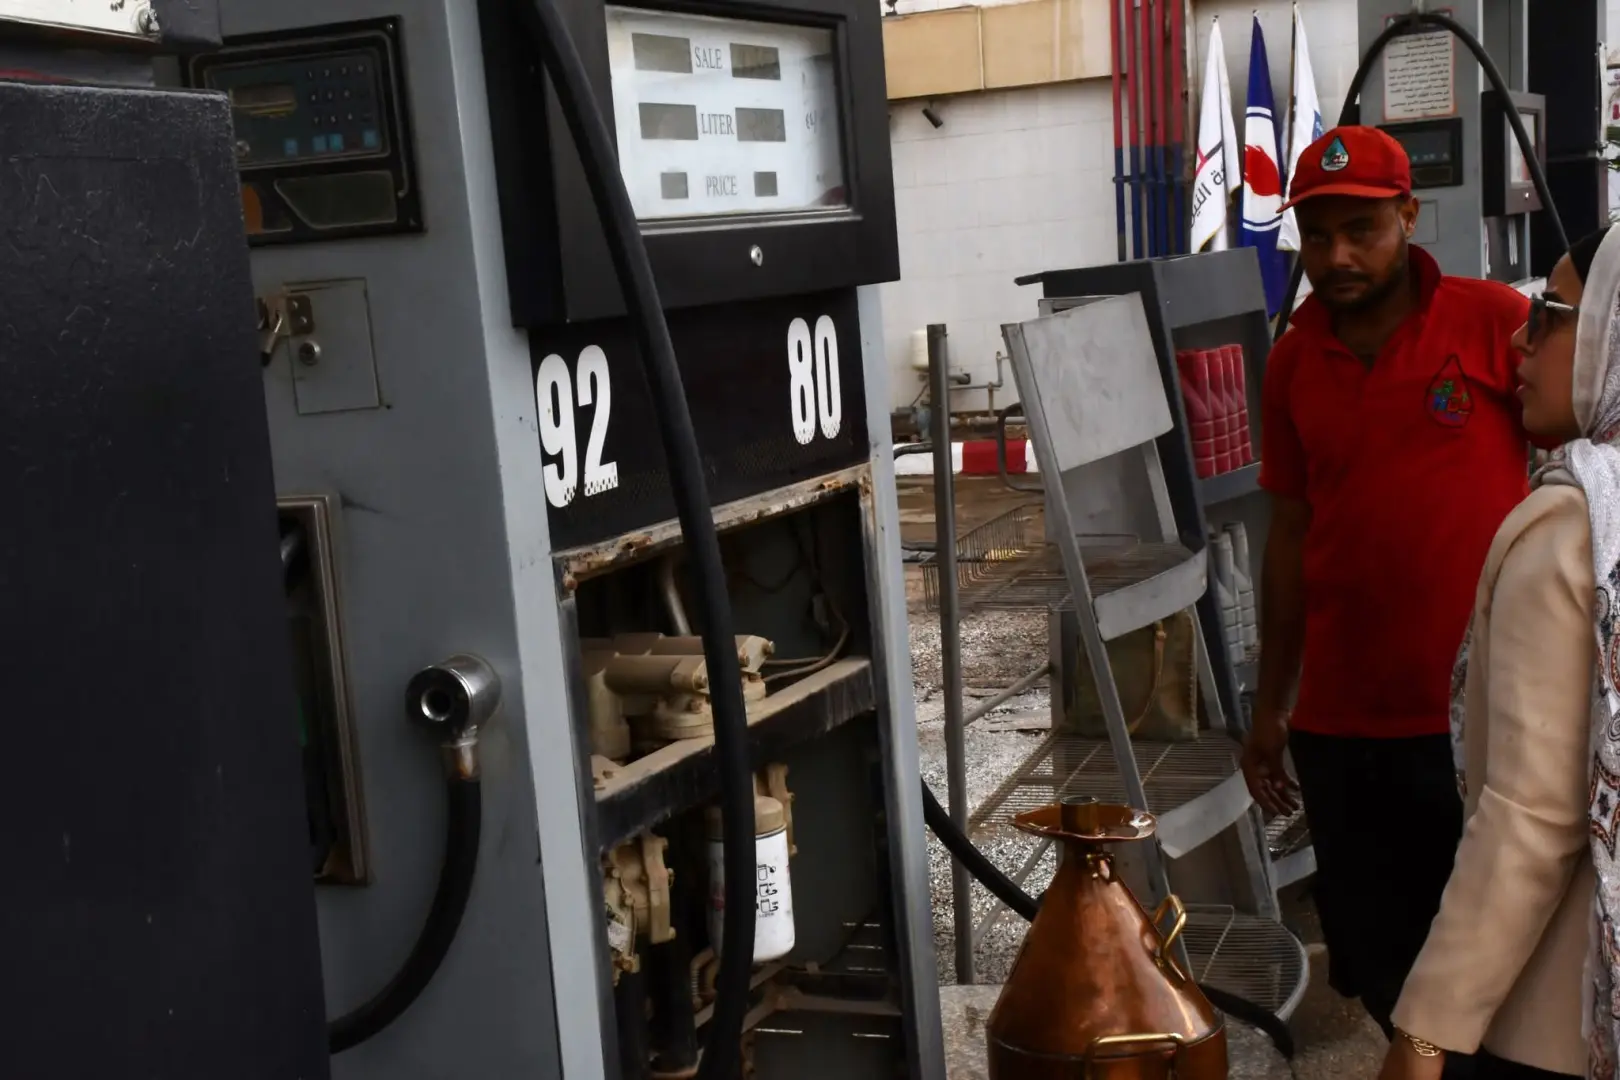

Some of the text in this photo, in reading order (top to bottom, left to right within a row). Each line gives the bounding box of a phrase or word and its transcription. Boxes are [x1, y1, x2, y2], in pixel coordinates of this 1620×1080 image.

[695, 46, 723, 70] SALE
[700, 113, 735, 135] LITER
[705, 175, 738, 197] PRICE
[786, 314, 842, 446] 80
[536, 344, 619, 509] 92
